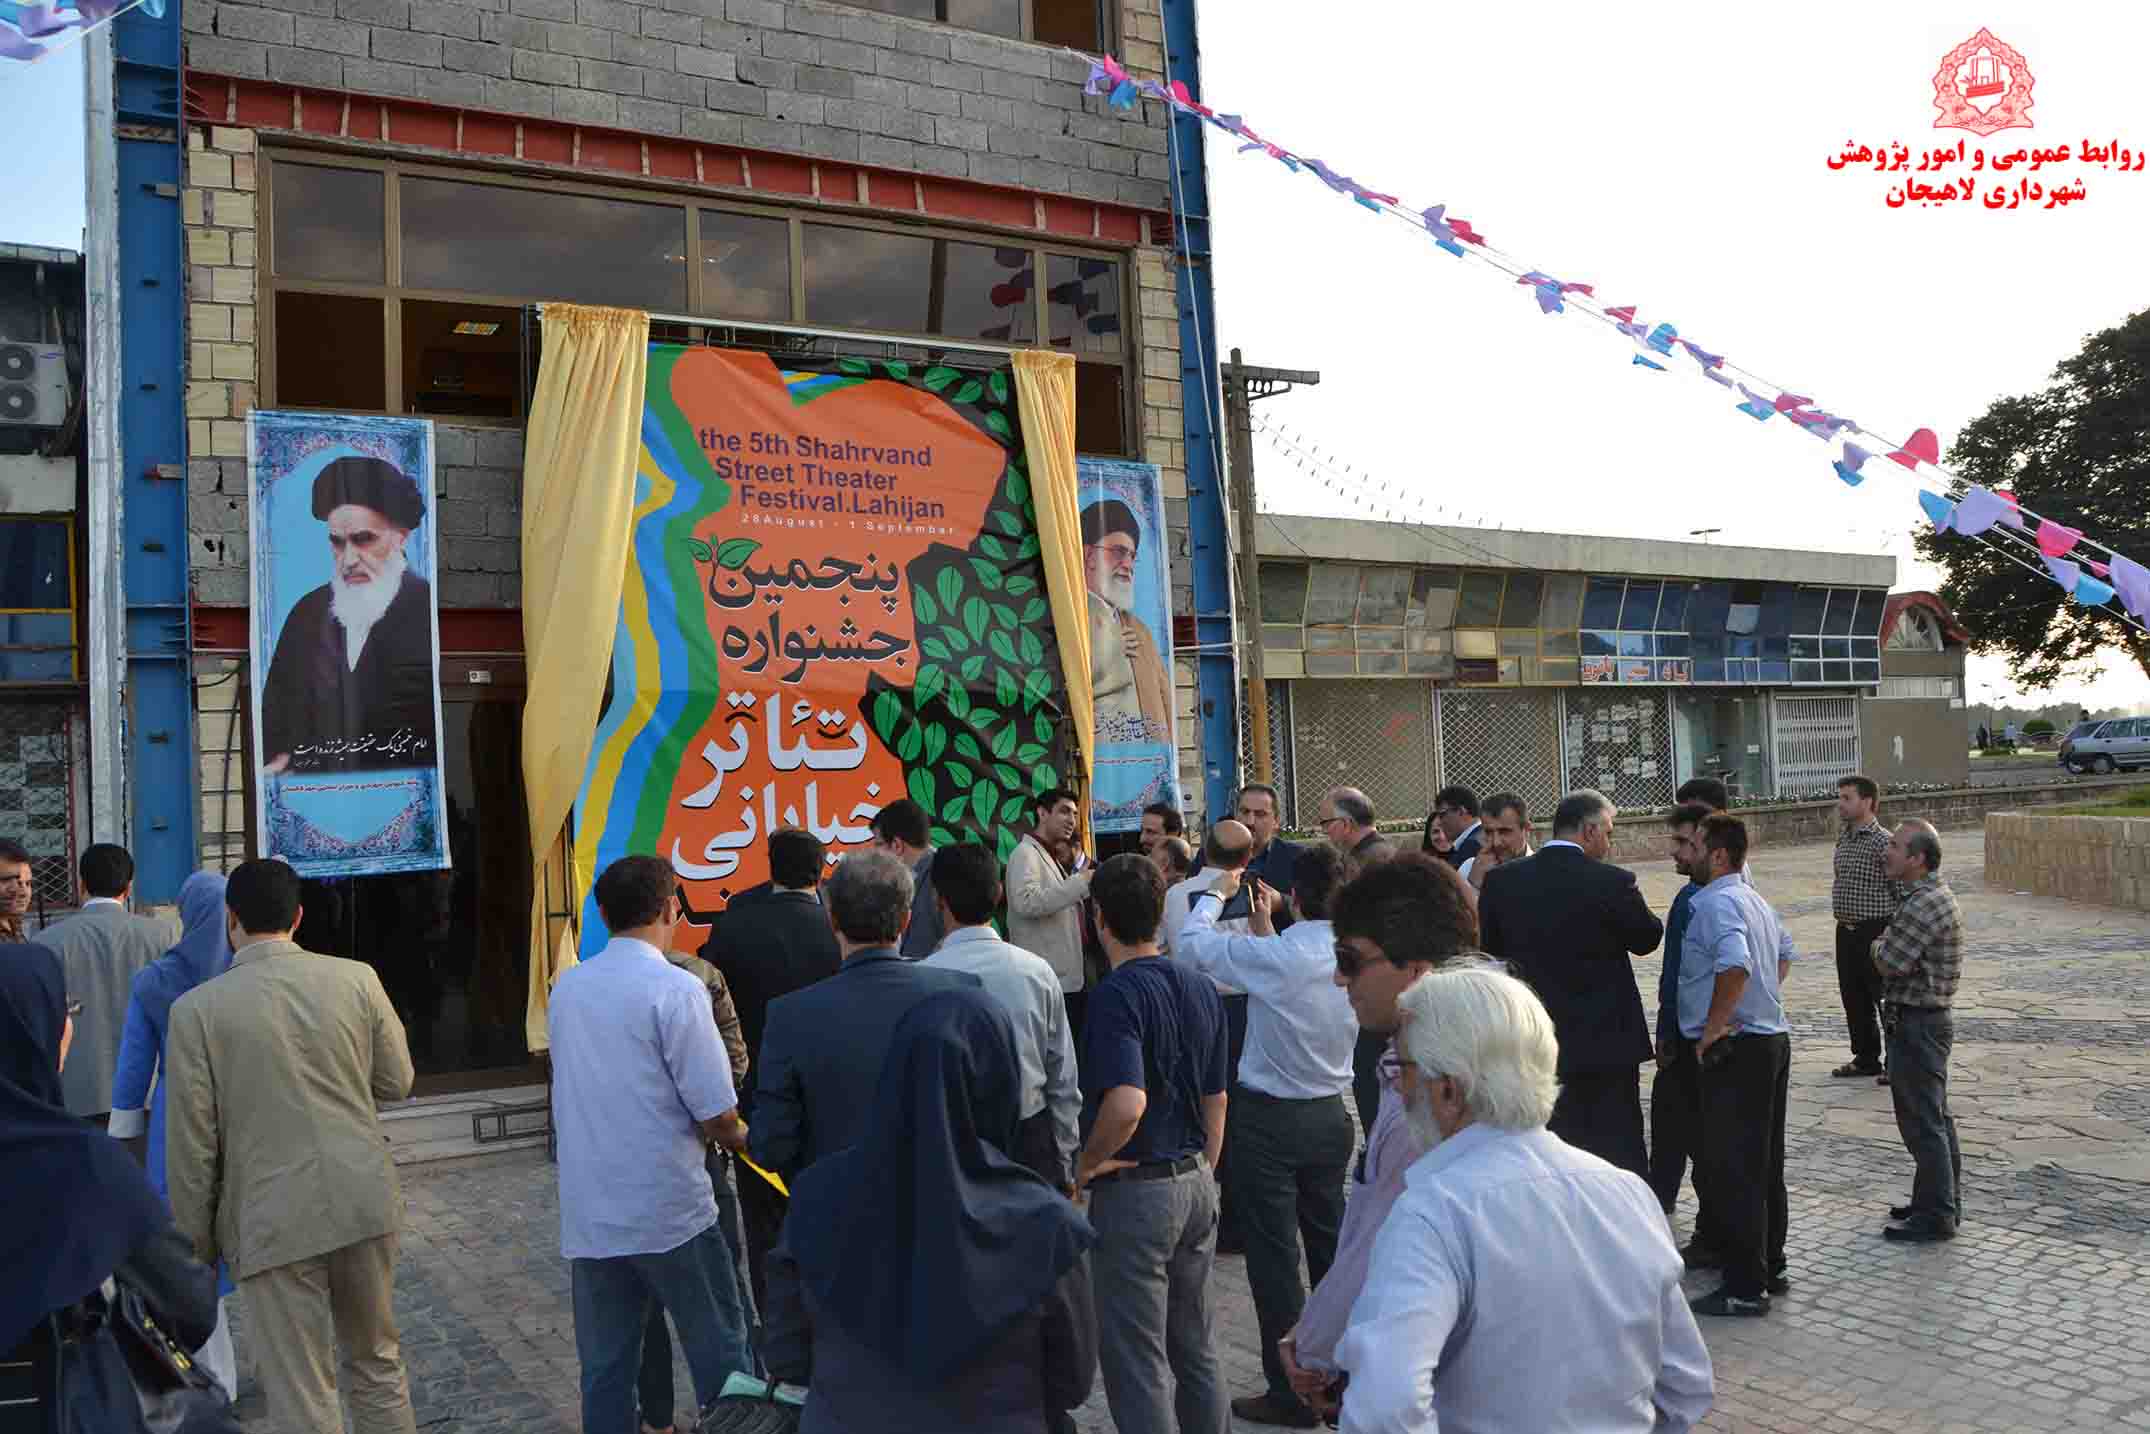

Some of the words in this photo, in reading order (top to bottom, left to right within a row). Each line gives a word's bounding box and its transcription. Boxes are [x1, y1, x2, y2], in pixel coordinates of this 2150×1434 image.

[700, 429, 741, 451] the
[749, 431, 790, 456] 5th
[795, 434, 932, 466] Shahrvand
[716, 456, 795, 484] Street
[802, 463, 897, 491] Theater
[863, 520, 954, 535] September
[708, 552, 900, 615] پنجمین
[721, 610, 911, 685] جشنواره
[293, 743, 319, 755] است
[412, 737, 428, 759] امام
[680, 690, 868, 809] تئاتر
